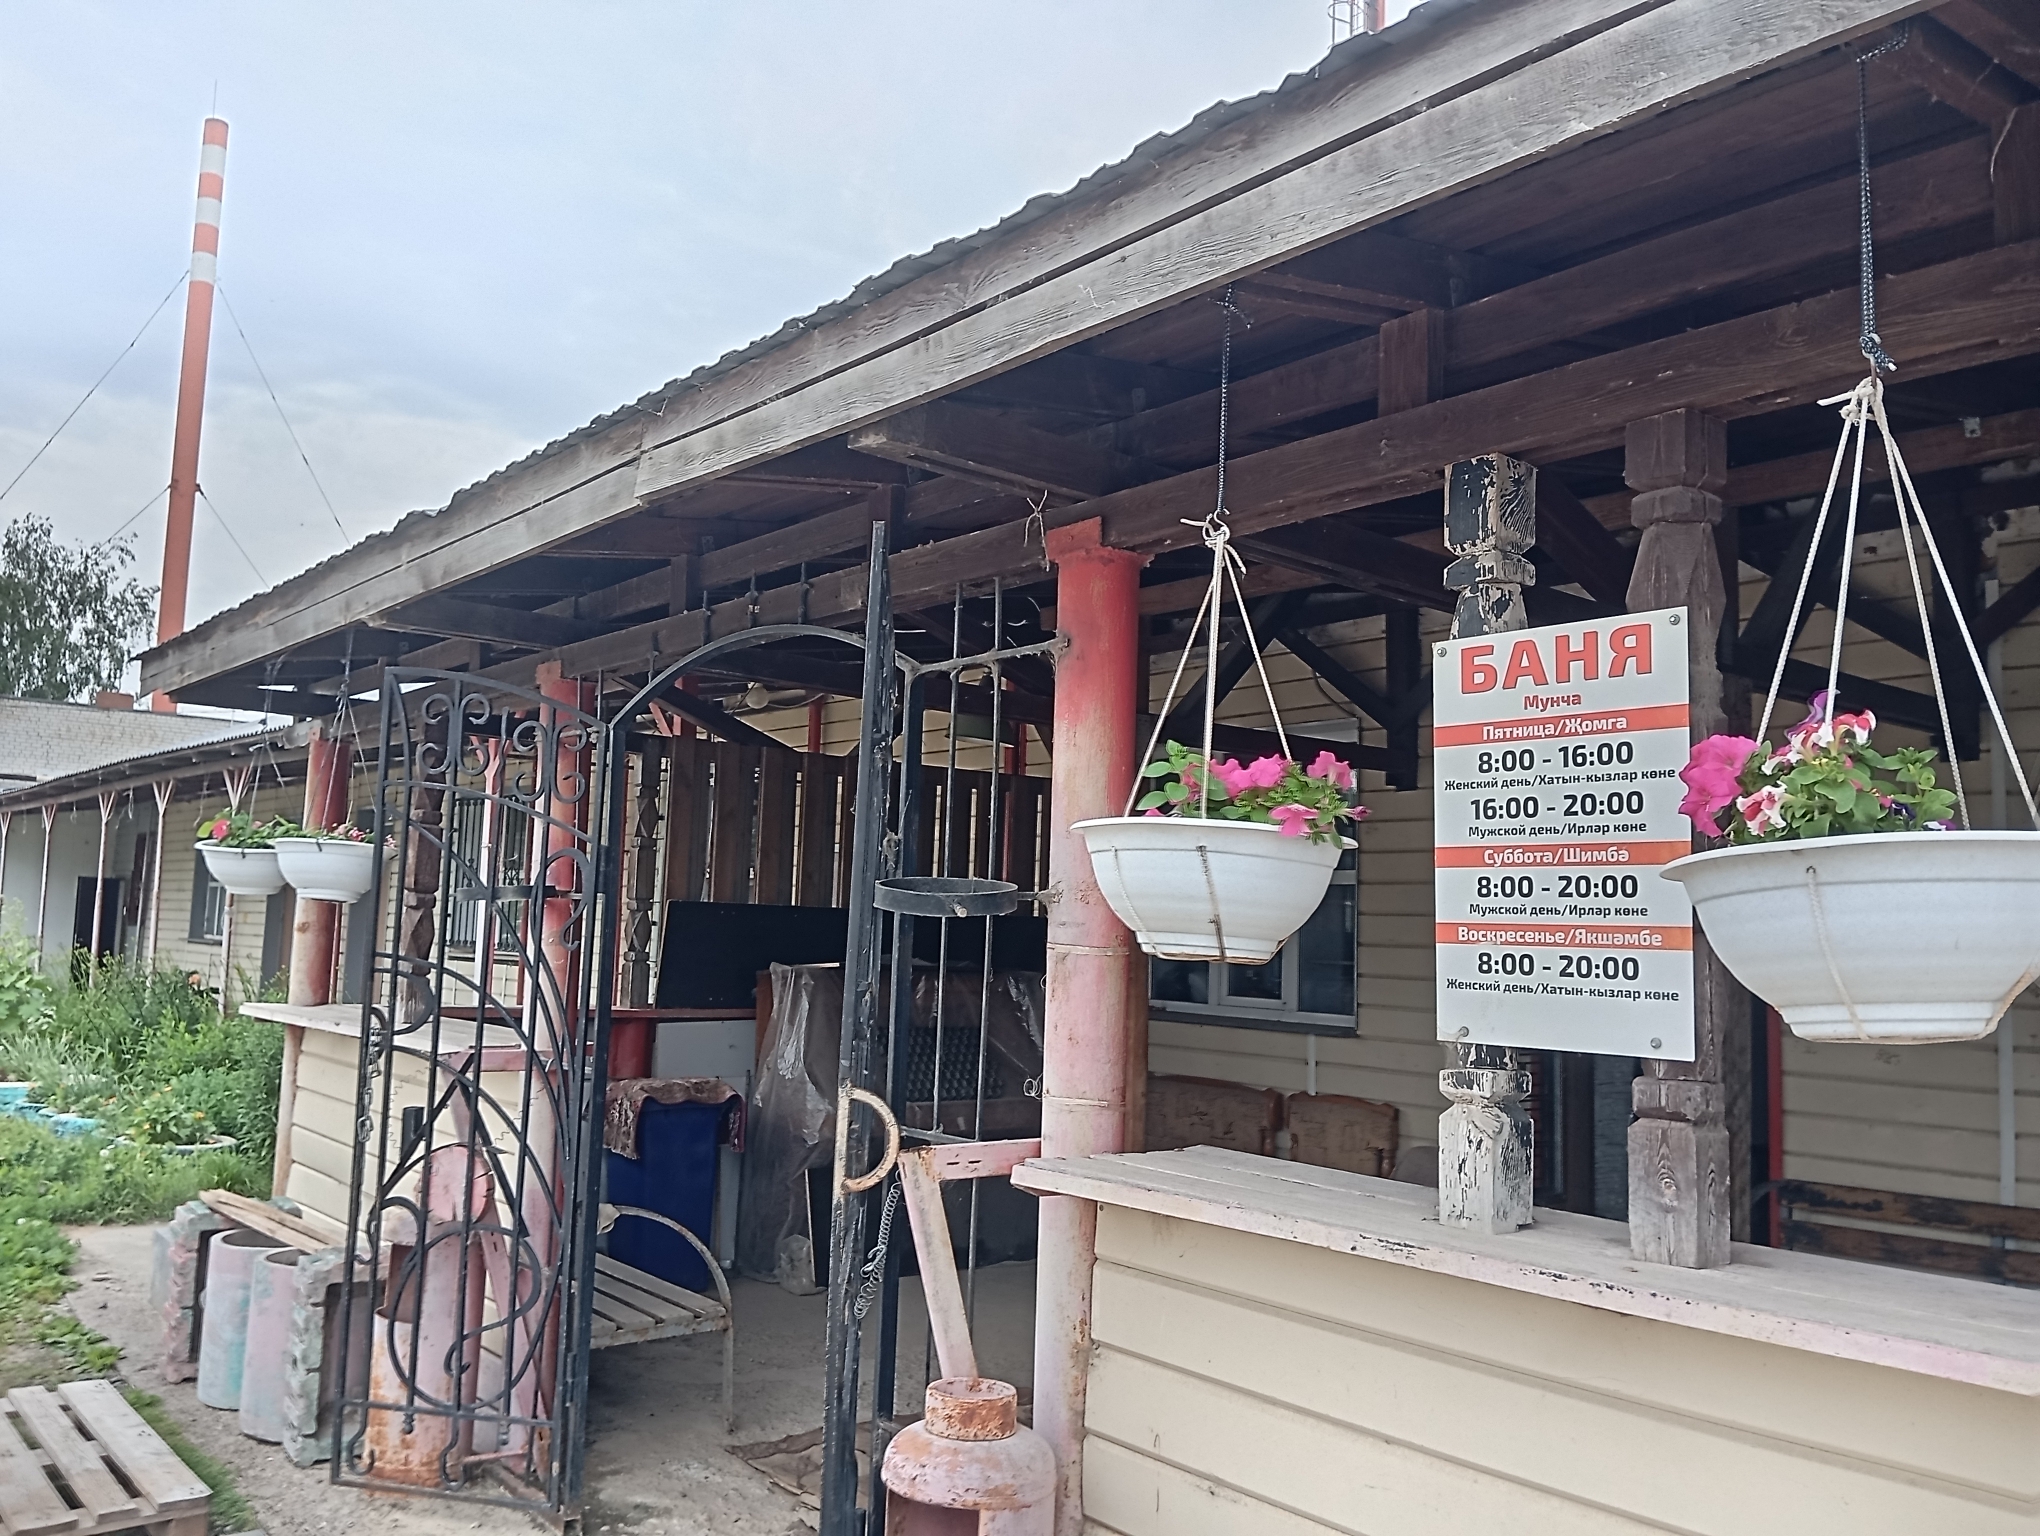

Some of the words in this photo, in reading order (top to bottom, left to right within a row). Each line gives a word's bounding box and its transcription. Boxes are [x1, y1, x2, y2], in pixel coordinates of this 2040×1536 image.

[1461, 624, 1652, 694] БАНЯ
[1524, 694, 1582, 712] Мунча
[1483, 716, 1627, 741] Пятница/Җомга
[1478, 749, 1534, 774] 8:00
[1558, 741, 1633, 768] 16:00
[1444, 778, 1498, 791] Женский
[1501, 770, 1638, 789] день/Хатын-кызлар
[1641, 769, 1675, 779] көне
[1470, 796, 1539, 820] 16:00
[1564, 791, 1644, 816] 20:00
[1468, 825, 1526, 839] Мужской
[1613, 822, 1647, 832] көне
[1477, 876, 1534, 898] 8:00
[1558, 875, 1638, 898] 20:00
[1469, 904, 1527, 917] Мужской
[1615, 906, 1648, 917] көне
[1478, 952, 1534, 976] 8:00
[1559, 955, 1639, 981] 20:00
[1446, 978, 1500, 992] Женский
[1503, 982, 1641, 1001] день/Хатын-кызлар
[1644, 991, 1679, 1001] көне
